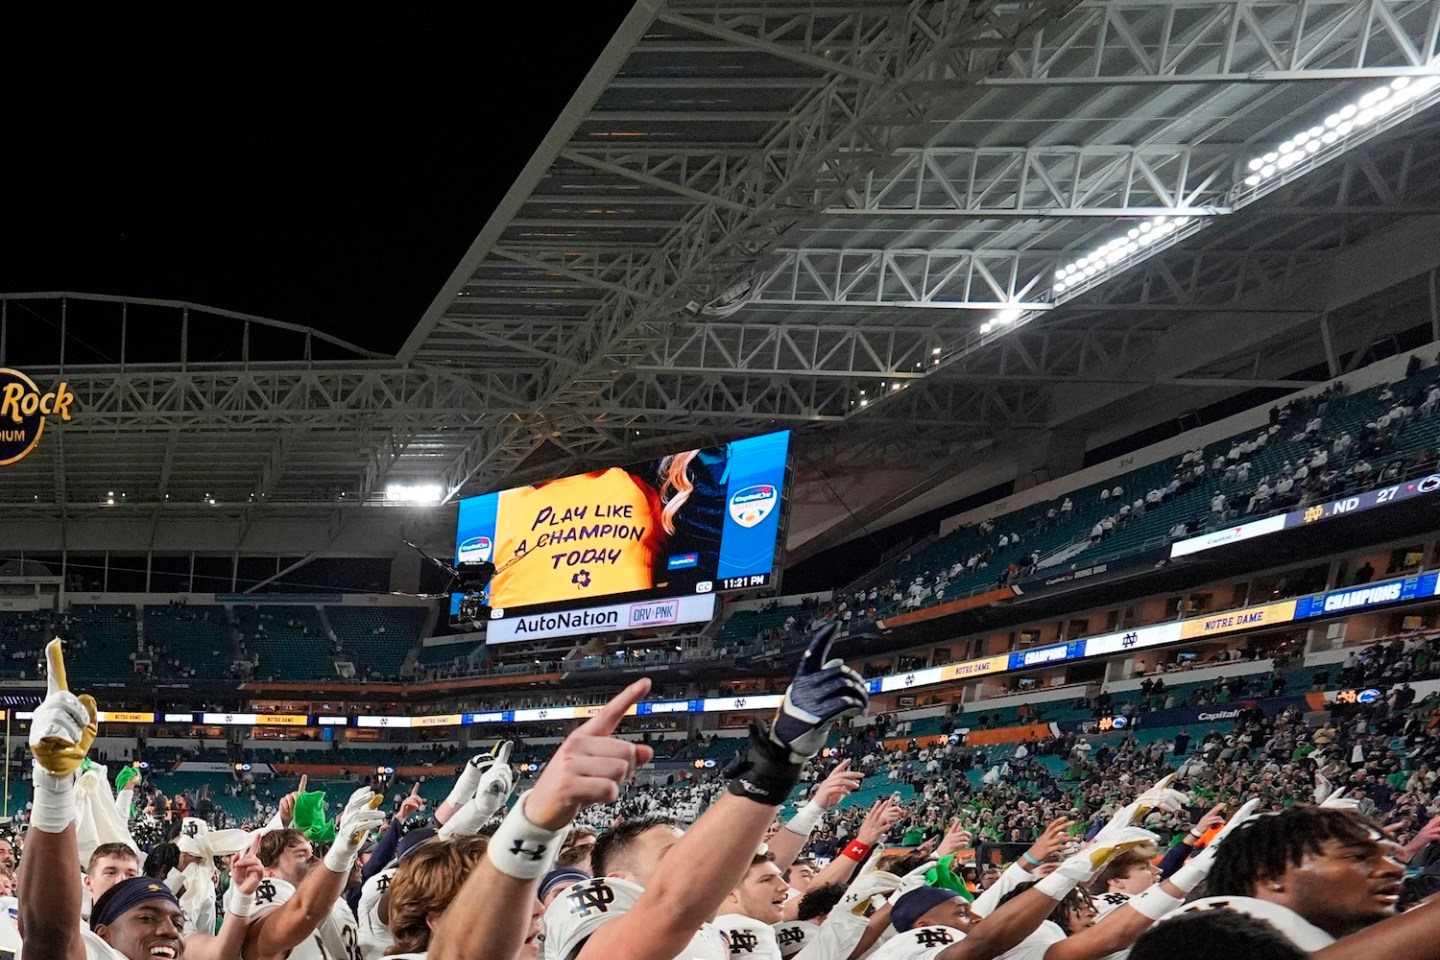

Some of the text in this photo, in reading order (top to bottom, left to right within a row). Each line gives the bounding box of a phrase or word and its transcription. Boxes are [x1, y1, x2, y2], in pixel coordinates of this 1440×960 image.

[0, 382, 75, 424] Rock
[1332, 487, 1399, 516] ND 27
[531, 505, 633, 531] PLAY LIKE
[514, 525, 646, 554] A CHAMPION
[551, 548, 621, 570] TODAY
[697, 582, 711, 592] CC
[723, 574, 764, 589] 11:21 PM
[1324, 583, 1402, 613] CHAMPIONS
[514, 610, 618, 634] AutoNation
[633, 601, 673, 621] DRV PNK
[1204, 611, 1264, 631] NOTRE DAME
[1023, 645, 1068, 665] CHAMPIONS
[954, 661, 991, 676] NOTRE DAME
